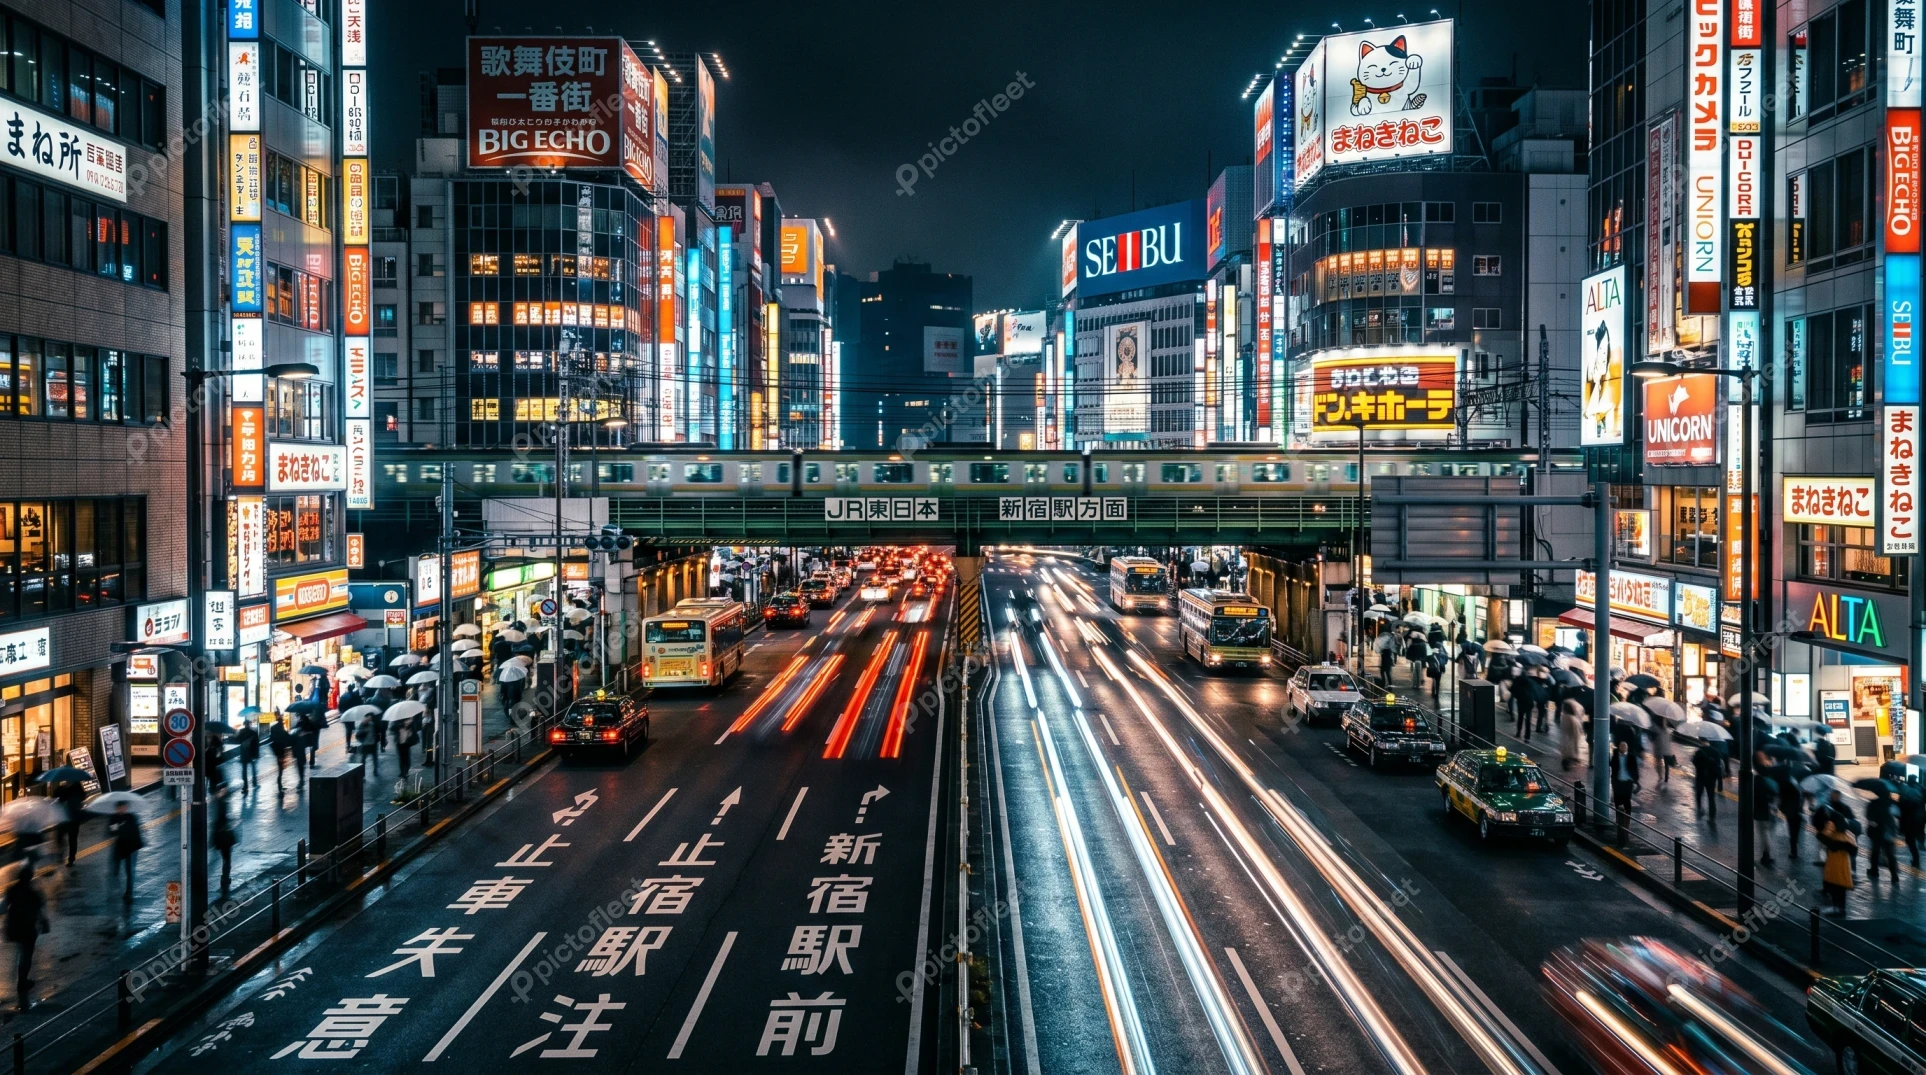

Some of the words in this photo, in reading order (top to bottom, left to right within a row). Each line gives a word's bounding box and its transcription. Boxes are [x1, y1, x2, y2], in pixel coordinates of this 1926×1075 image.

[1894, 0, 1915, 54] 舞町
[481, 45, 608, 77] 歌舞伎町
[497, 81, 593, 112] 一番街
[6, 111, 82, 180] まね所
[478, 129, 528, 155] BIG
[534, 129, 611, 155] ECHO
[1331, 116, 1444, 154] まねきねこ
[1891, 126, 1912, 173] BIG
[1891, 174, 1912, 236] ECHO
[348, 254, 363, 281] BIG
[1085, 222, 1184, 278] SEIBU
[348, 284, 363, 325] ECHO
[1586, 276, 1621, 315] ALTA
[1892, 301, 1912, 366] SEIBU
[1648, 414, 1712, 443] UNICORN
[278, 453, 330, 483] まねきねこ
[1889, 410, 1913, 538] まねきねこ
[826, 498, 938, 520] JR東日本
[1001, 498, 1126, 519] 新宿駅方面
[1791, 485, 1870, 517] まねきねこ
[1808, 591, 1887, 648] ALTA
[171, 715, 189, 730] 30
